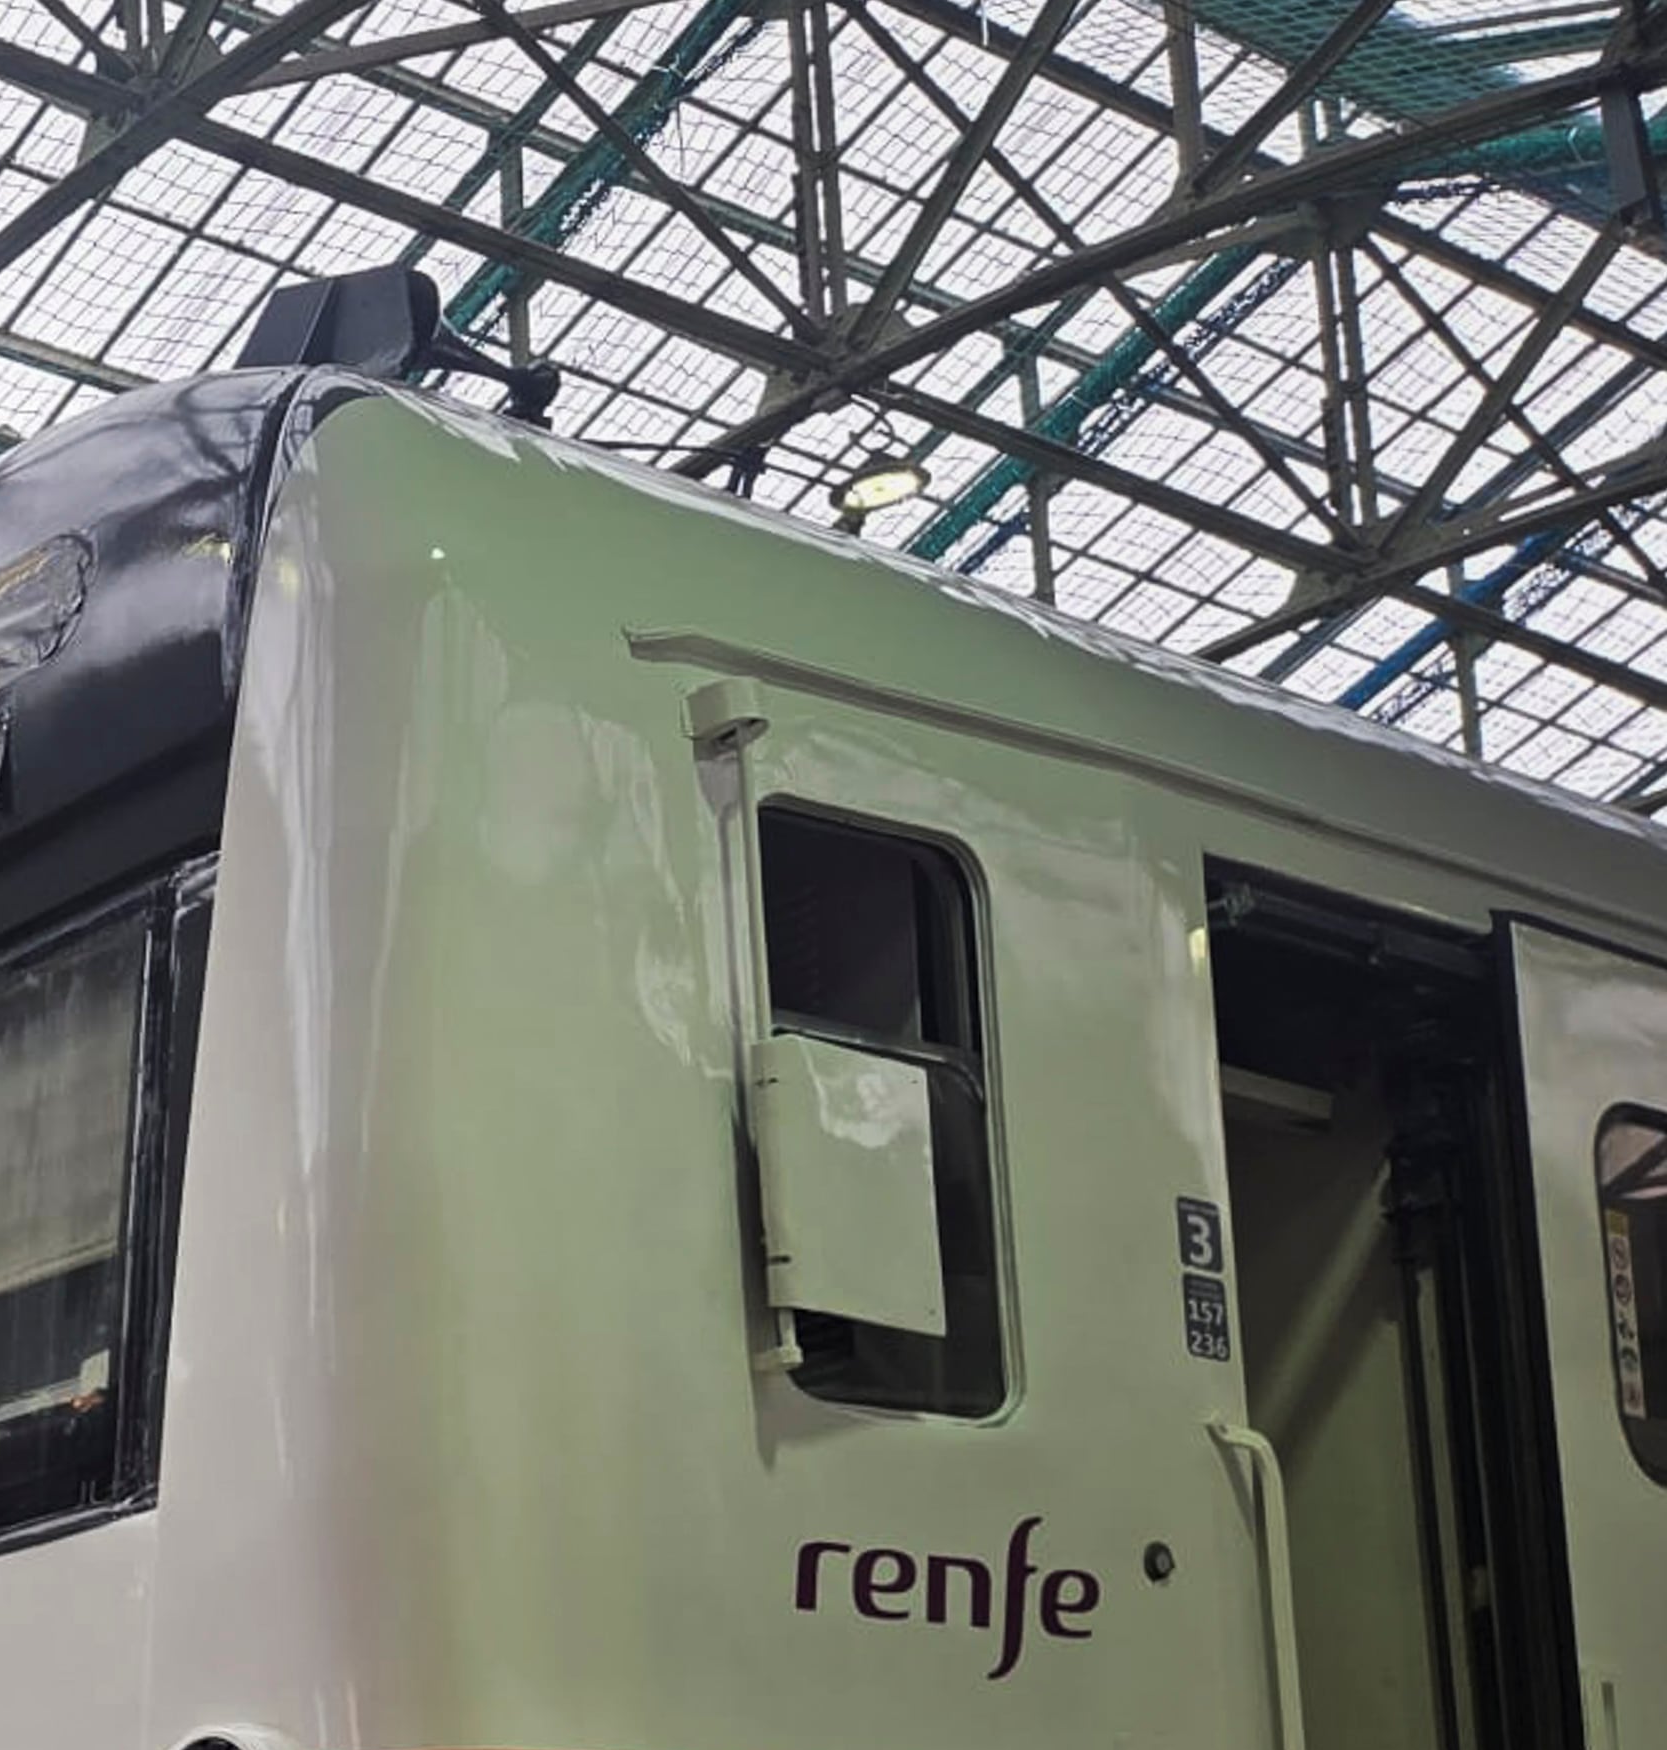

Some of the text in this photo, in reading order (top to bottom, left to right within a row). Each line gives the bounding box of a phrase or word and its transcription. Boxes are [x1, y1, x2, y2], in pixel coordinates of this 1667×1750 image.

[1187, 1213, 1213, 1266] 3
[1188, 1300, 1223, 1325] 157
[1190, 1331, 1228, 1358] 236
[794, 1515, 1101, 1681] renfe
